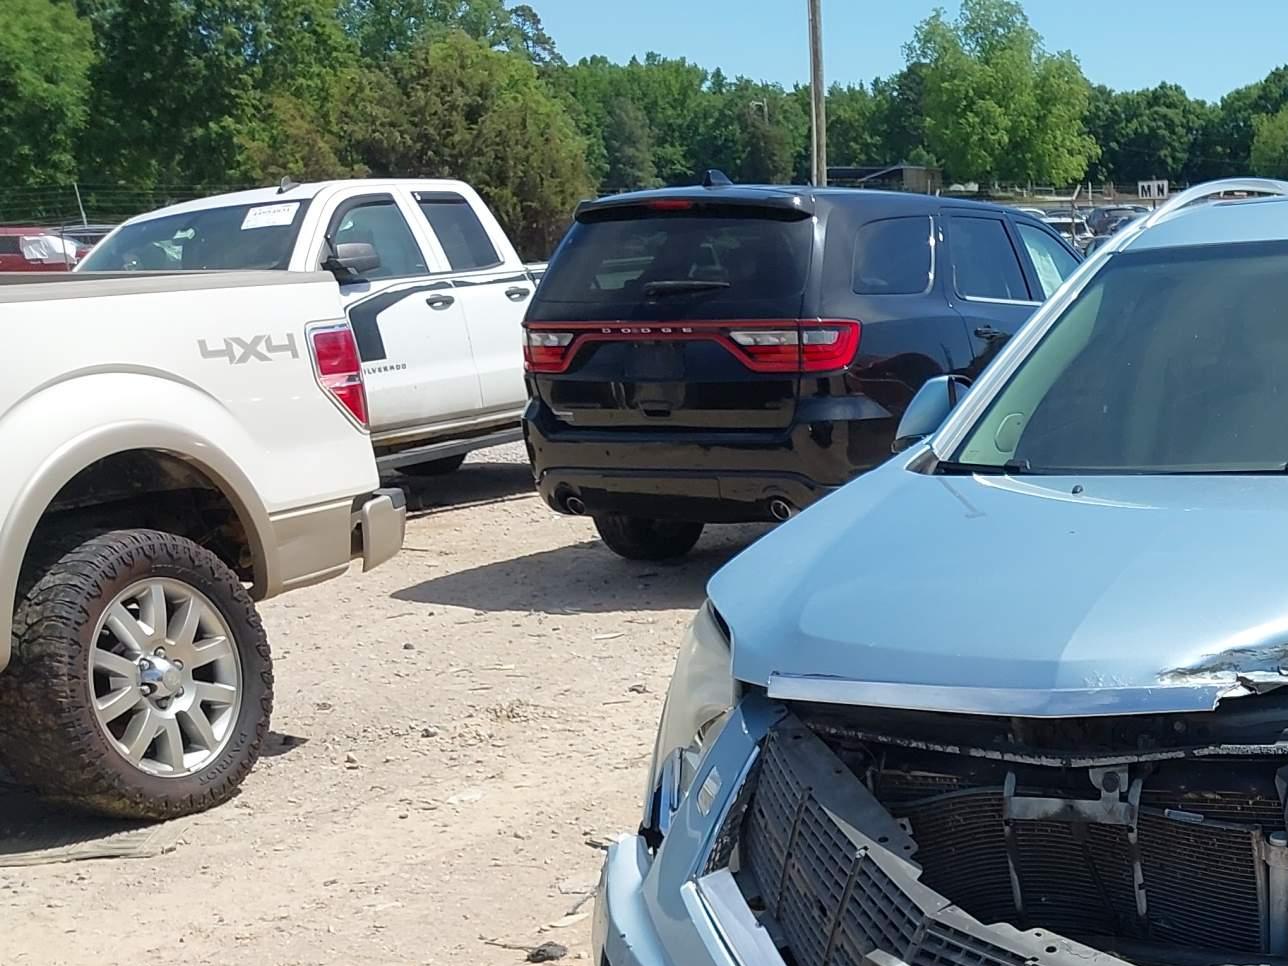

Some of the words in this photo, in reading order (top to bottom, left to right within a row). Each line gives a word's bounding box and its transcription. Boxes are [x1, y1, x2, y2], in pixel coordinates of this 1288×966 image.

[1141, 184, 1152, 197] M
[1157, 183, 1165, 197] N
[364, 363, 407, 375] ILVERADO
